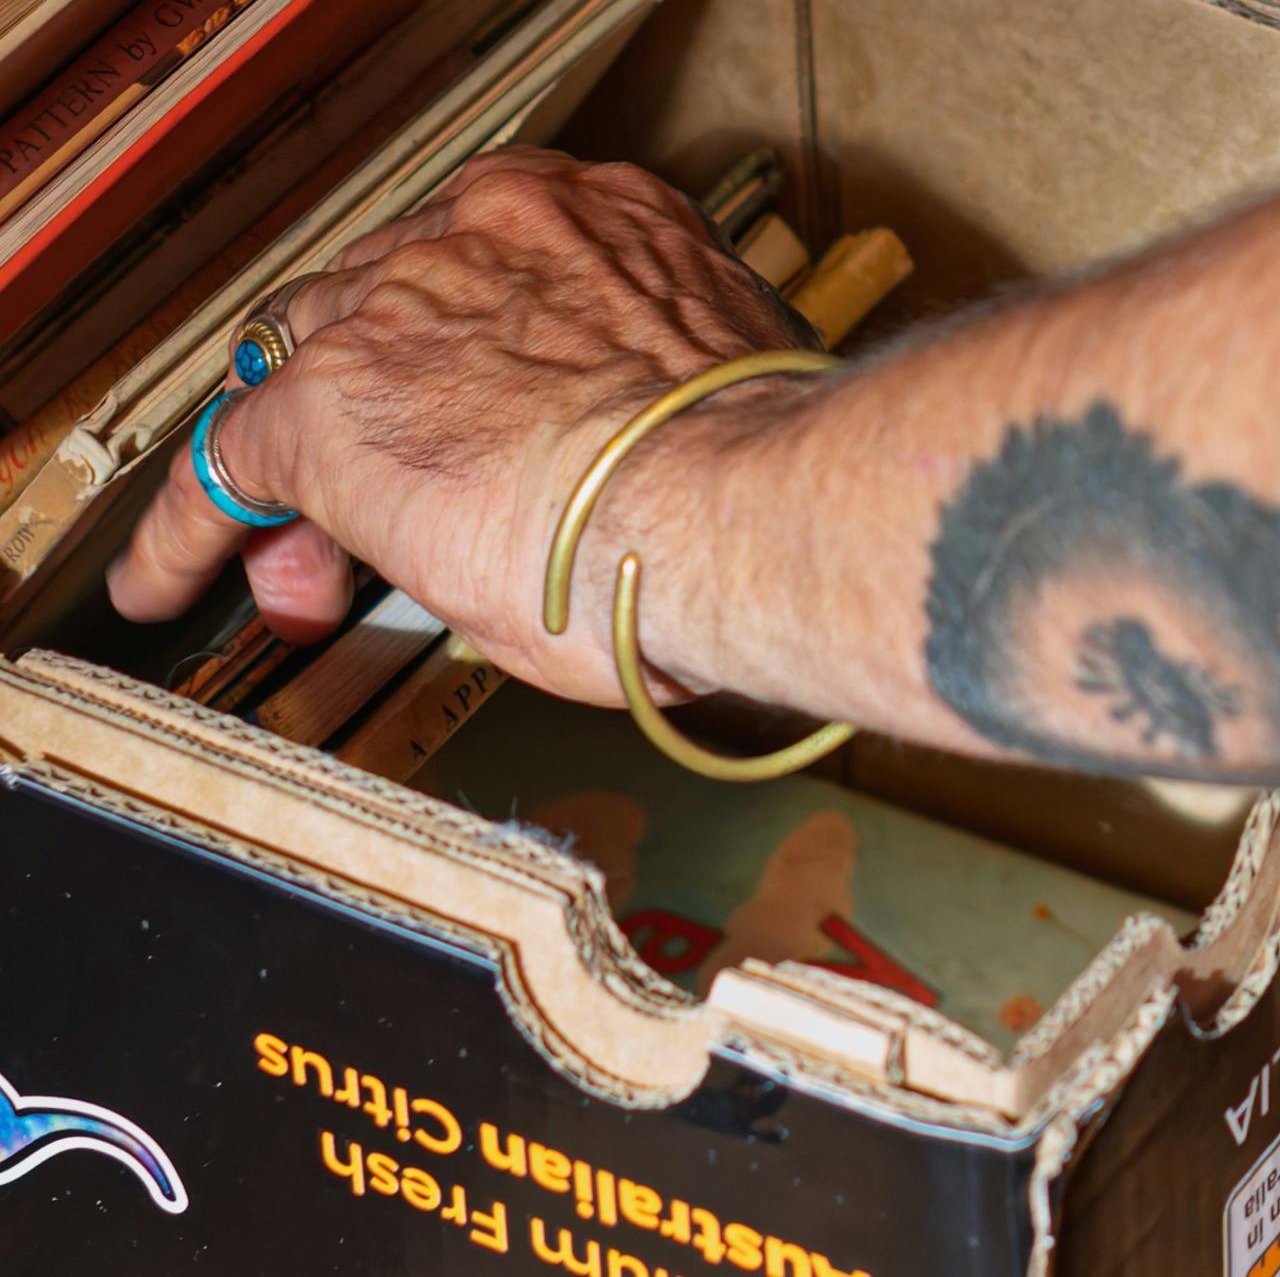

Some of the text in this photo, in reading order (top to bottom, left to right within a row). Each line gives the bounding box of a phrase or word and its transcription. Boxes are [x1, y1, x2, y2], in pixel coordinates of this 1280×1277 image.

[117, 31, 158, 62] by
[252, 1031, 463, 1156] Citrus
[320, 1130, 509, 1254] Fresh
[1246, 1218, 1264, 1250] in
